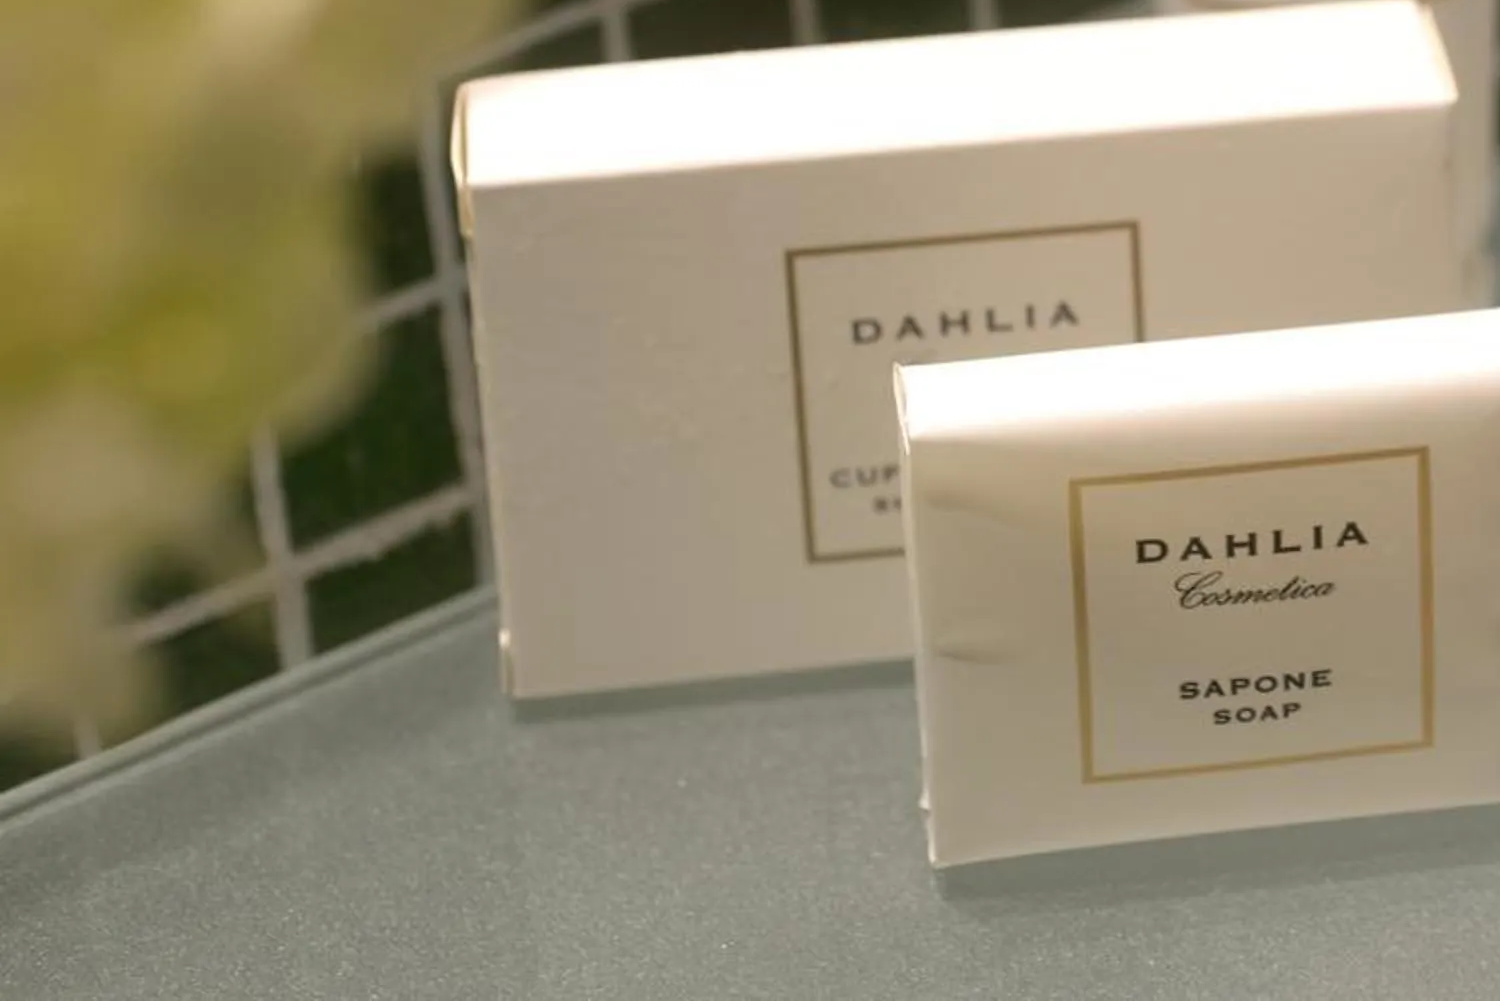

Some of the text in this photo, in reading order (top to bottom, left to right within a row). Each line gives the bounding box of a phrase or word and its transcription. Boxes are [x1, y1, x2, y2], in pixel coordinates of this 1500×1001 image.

[850, 300, 1079, 345] DAHLIA
[1135, 520, 1369, 564] DAHLIA
[1173, 571, 1337, 610] Cosmetica
[1179, 668, 1333, 700] SAPONE
[1213, 701, 1303, 726] SOAP
